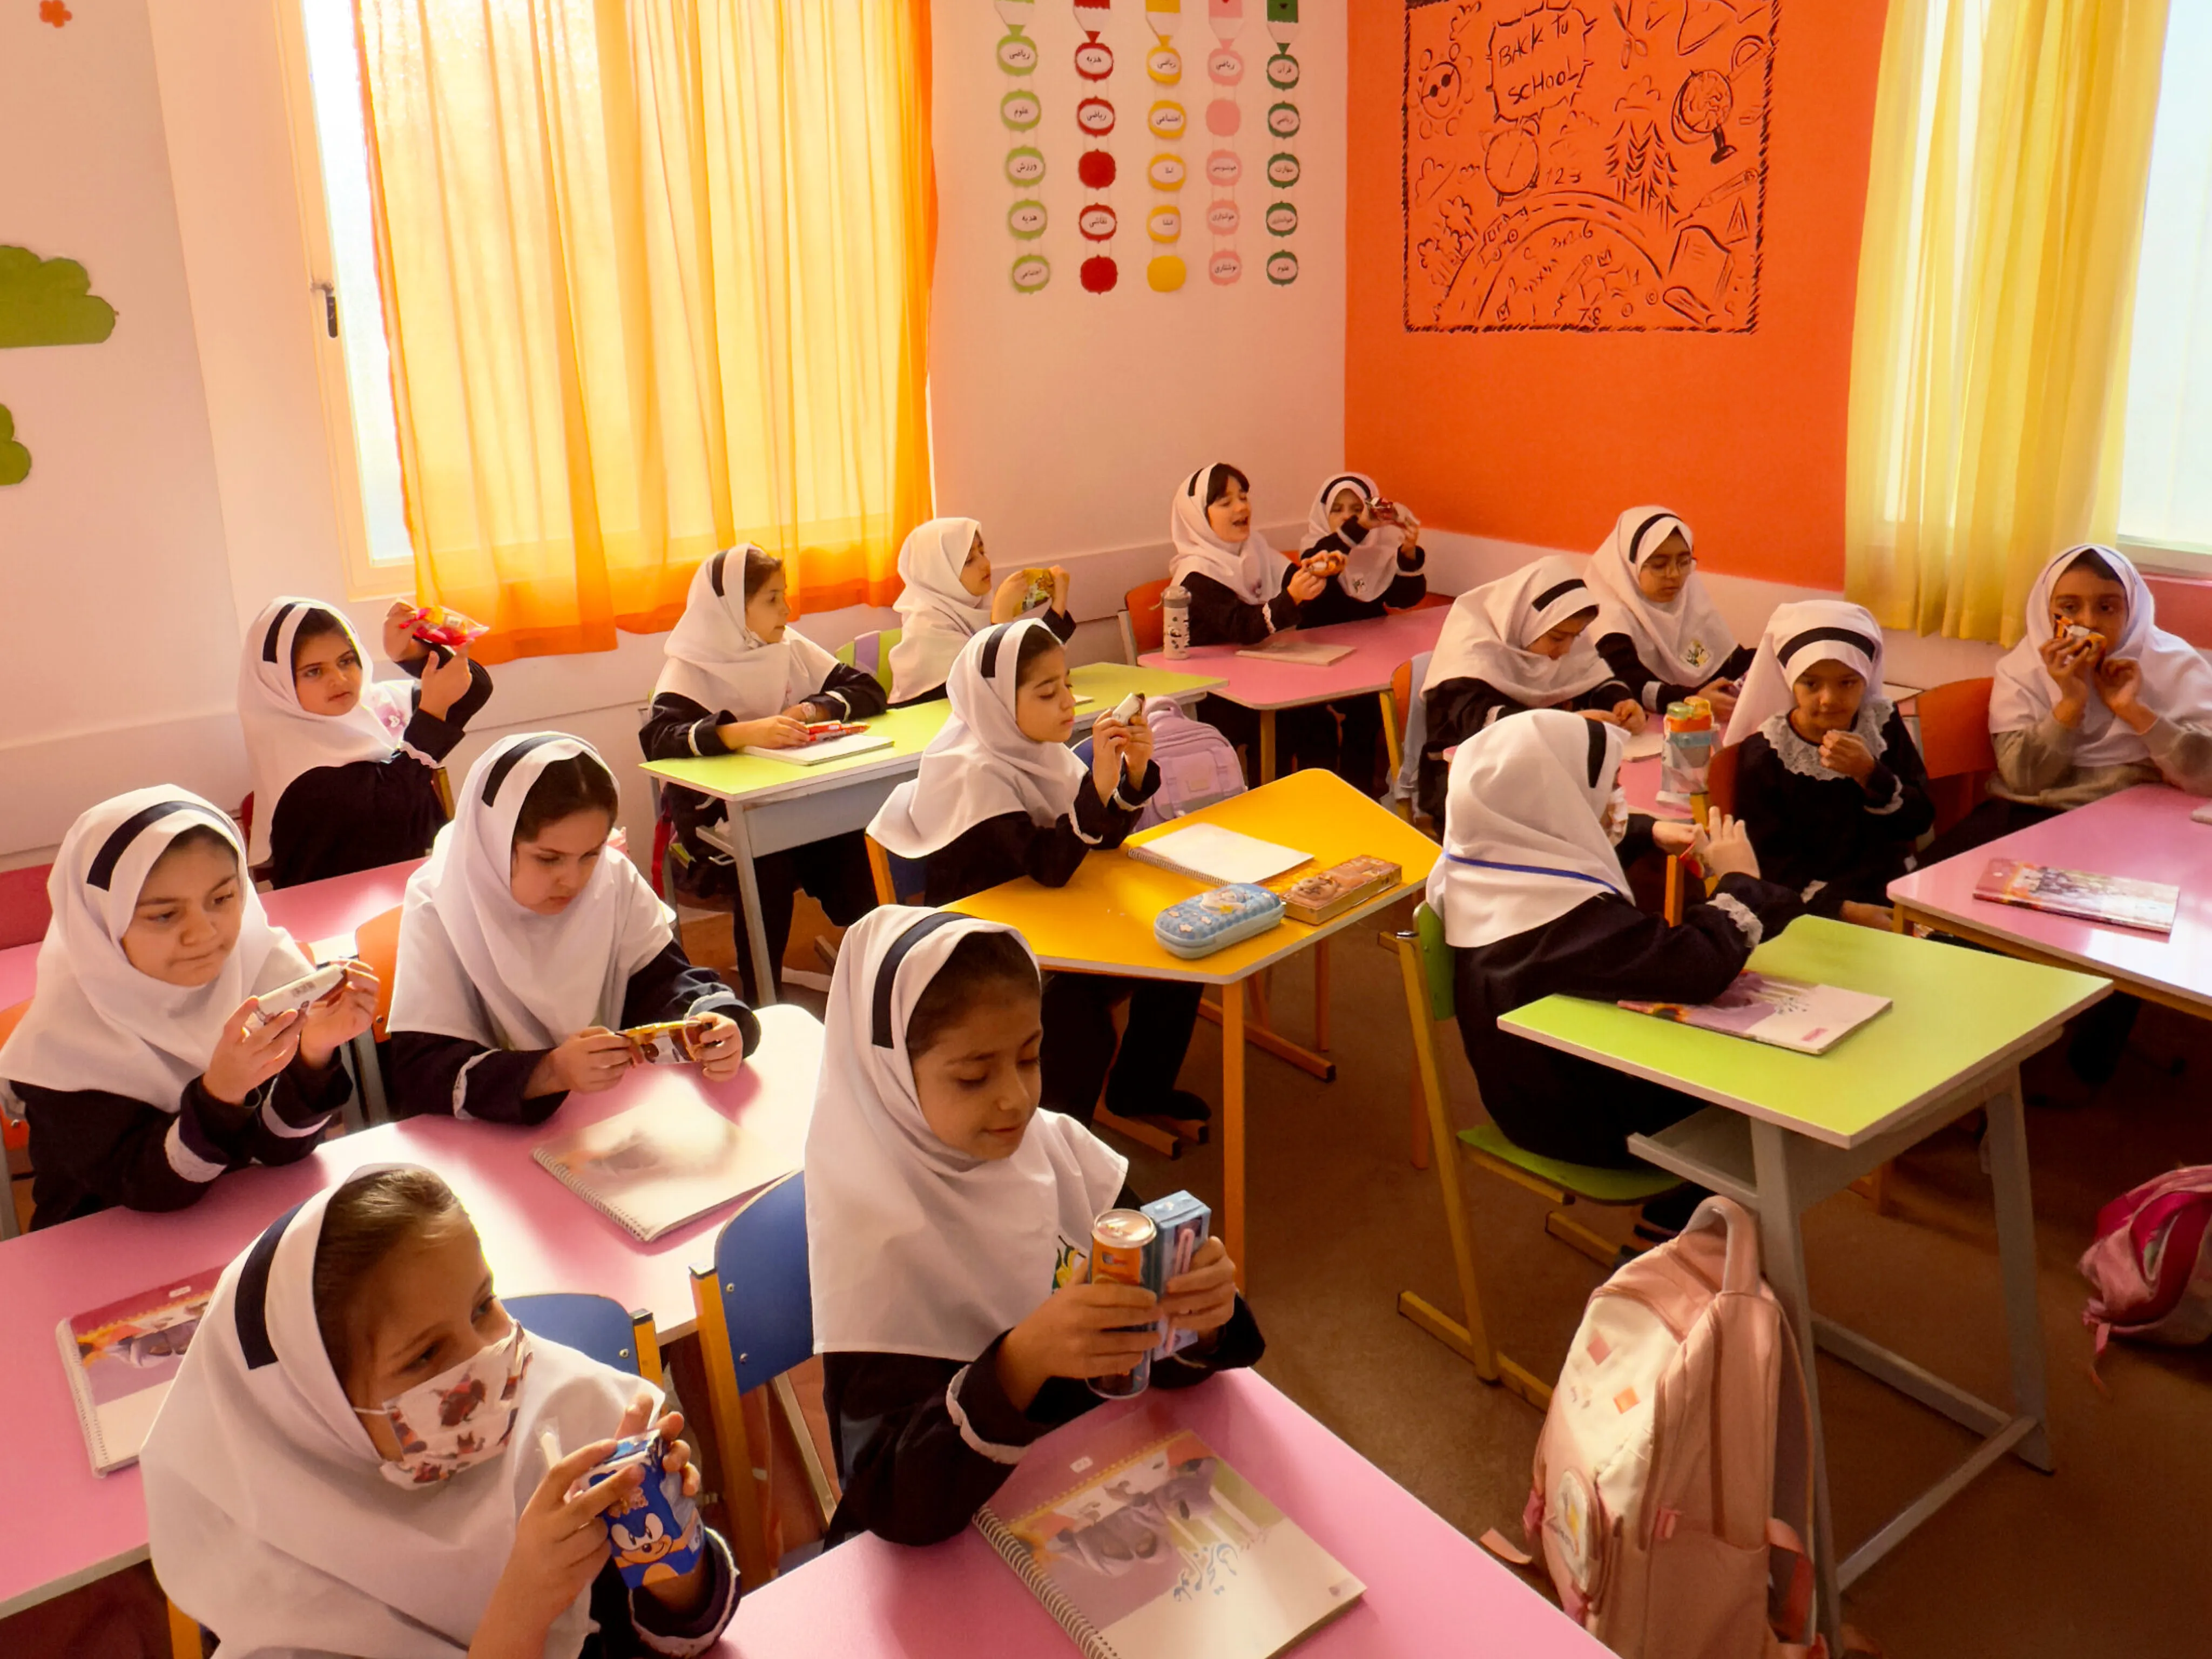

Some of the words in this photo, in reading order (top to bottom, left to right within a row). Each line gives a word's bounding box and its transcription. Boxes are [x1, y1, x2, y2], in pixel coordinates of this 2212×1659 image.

[1499, 22, 1544, 69] BACK
[1009, 49, 1030, 60] ریاضی
[1508, 56, 1579, 105] SCHOOL
[1087, 110, 1107, 122] ریاضی
[1016, 162, 1037, 173] ورزش
